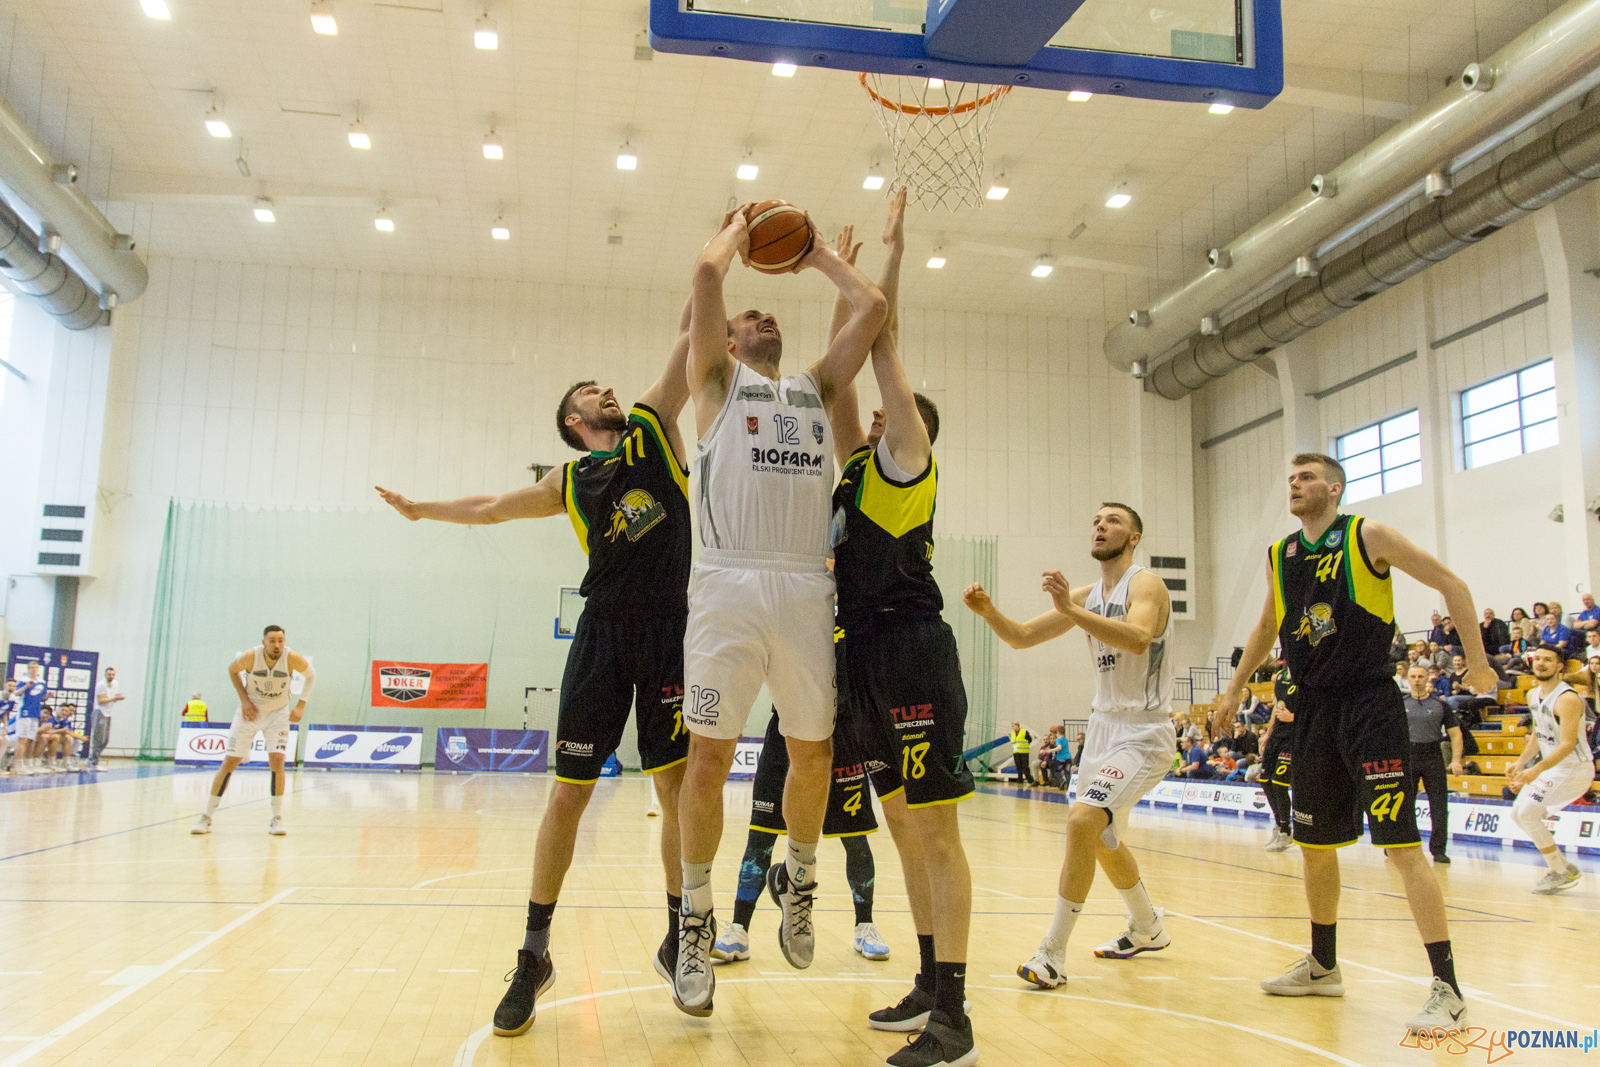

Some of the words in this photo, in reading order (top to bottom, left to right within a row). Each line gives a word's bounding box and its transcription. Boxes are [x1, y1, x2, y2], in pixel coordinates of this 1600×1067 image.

[773, 413, 800, 445] 12
[622, 426, 646, 466] 11
[1315, 549, 1344, 583] 41
[387, 677, 424, 688] JOKER
[691, 684, 720, 718] 12
[890, 704, 935, 723] TUZ
[321, 742, 350, 752] atrem
[377, 743, 405, 753] atrem
[565, 741, 594, 750] KONAR
[902, 741, 931, 780] 18
[1362, 759, 1404, 774] TUZ
[833, 763, 864, 778] TUZ
[1100, 767, 1119, 778] KIA
[842, 791, 862, 816] 4
[1084, 788, 1108, 802] PBG
[1220, 791, 1243, 804] NICKEL
[1370, 790, 1405, 823] 41
[1474, 812, 1500, 833] PBG
